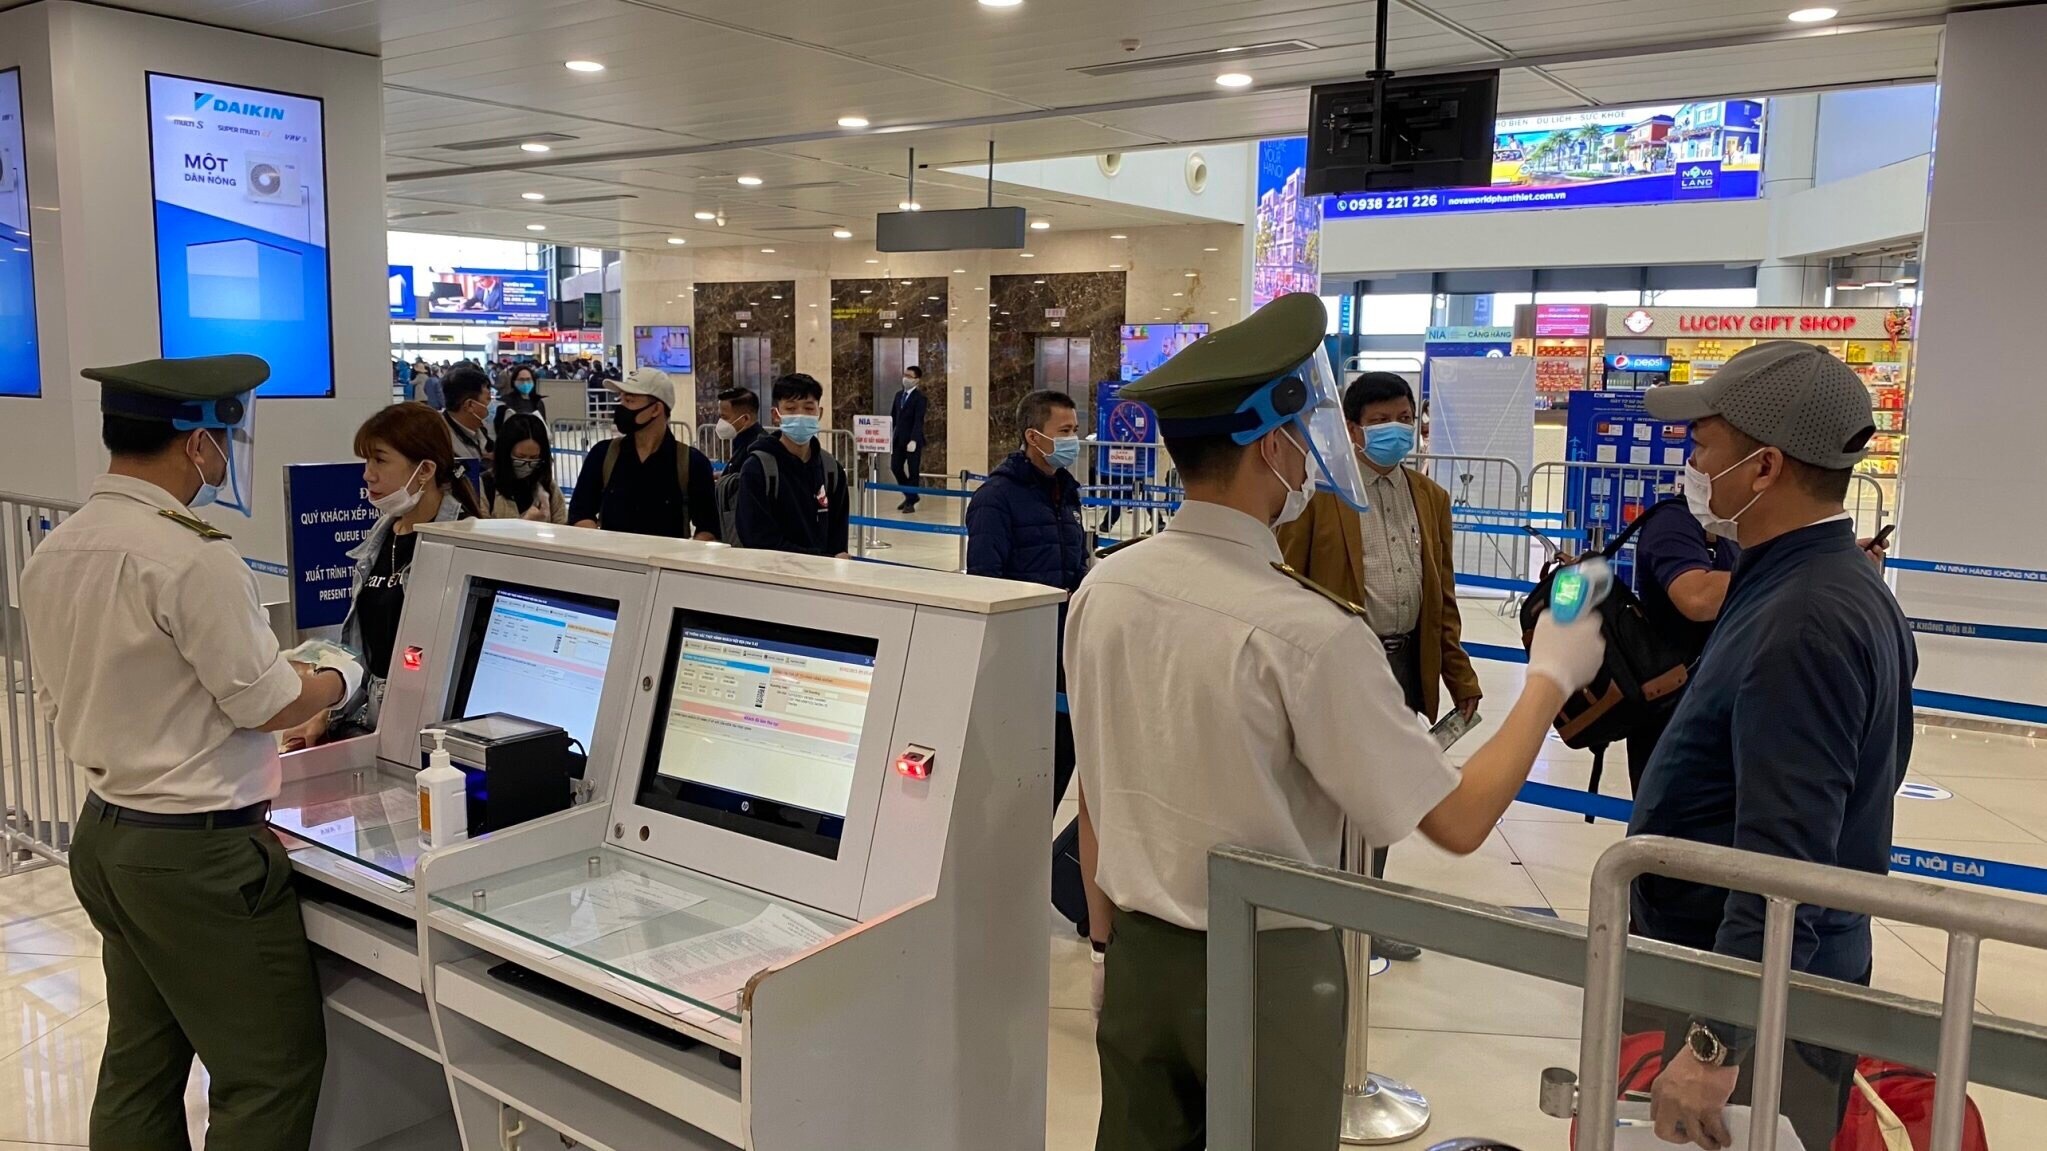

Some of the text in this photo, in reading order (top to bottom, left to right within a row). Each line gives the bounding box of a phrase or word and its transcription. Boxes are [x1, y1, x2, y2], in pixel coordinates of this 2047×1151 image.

[213, 99, 285, 120] DAIKIN
[184, 152, 228, 175] MỘT
[184, 172, 205, 183] DÀN
[1682, 179, 1713, 187] LAND
[1349, 194, 1438, 211] 0938 221 226
[1448, 192, 1567, 205] novaworldphanthiet.com.vn
[1679, 315, 1857, 332] LUCKY GIFT SHOP
[1428, 331, 1447, 339] NIA
[1634, 357, 1663, 368] pepsi
[301, 509, 319, 525] QUÝ
[320, 507, 350, 523] KHÁCH
[351, 504, 367, 520] XẾP
[335, 530, 360, 543] QUEUE
[305, 564, 325, 582] XUẤT
[325, 564, 347, 580] TRÌNH
[1934, 563, 1947, 571] AN
[1947, 565, 1968, 574] NINH
[319, 588, 348, 601] PRESENT
[1915, 855, 1947, 872] NỘI
[1952, 861, 1985, 877] BÀI
